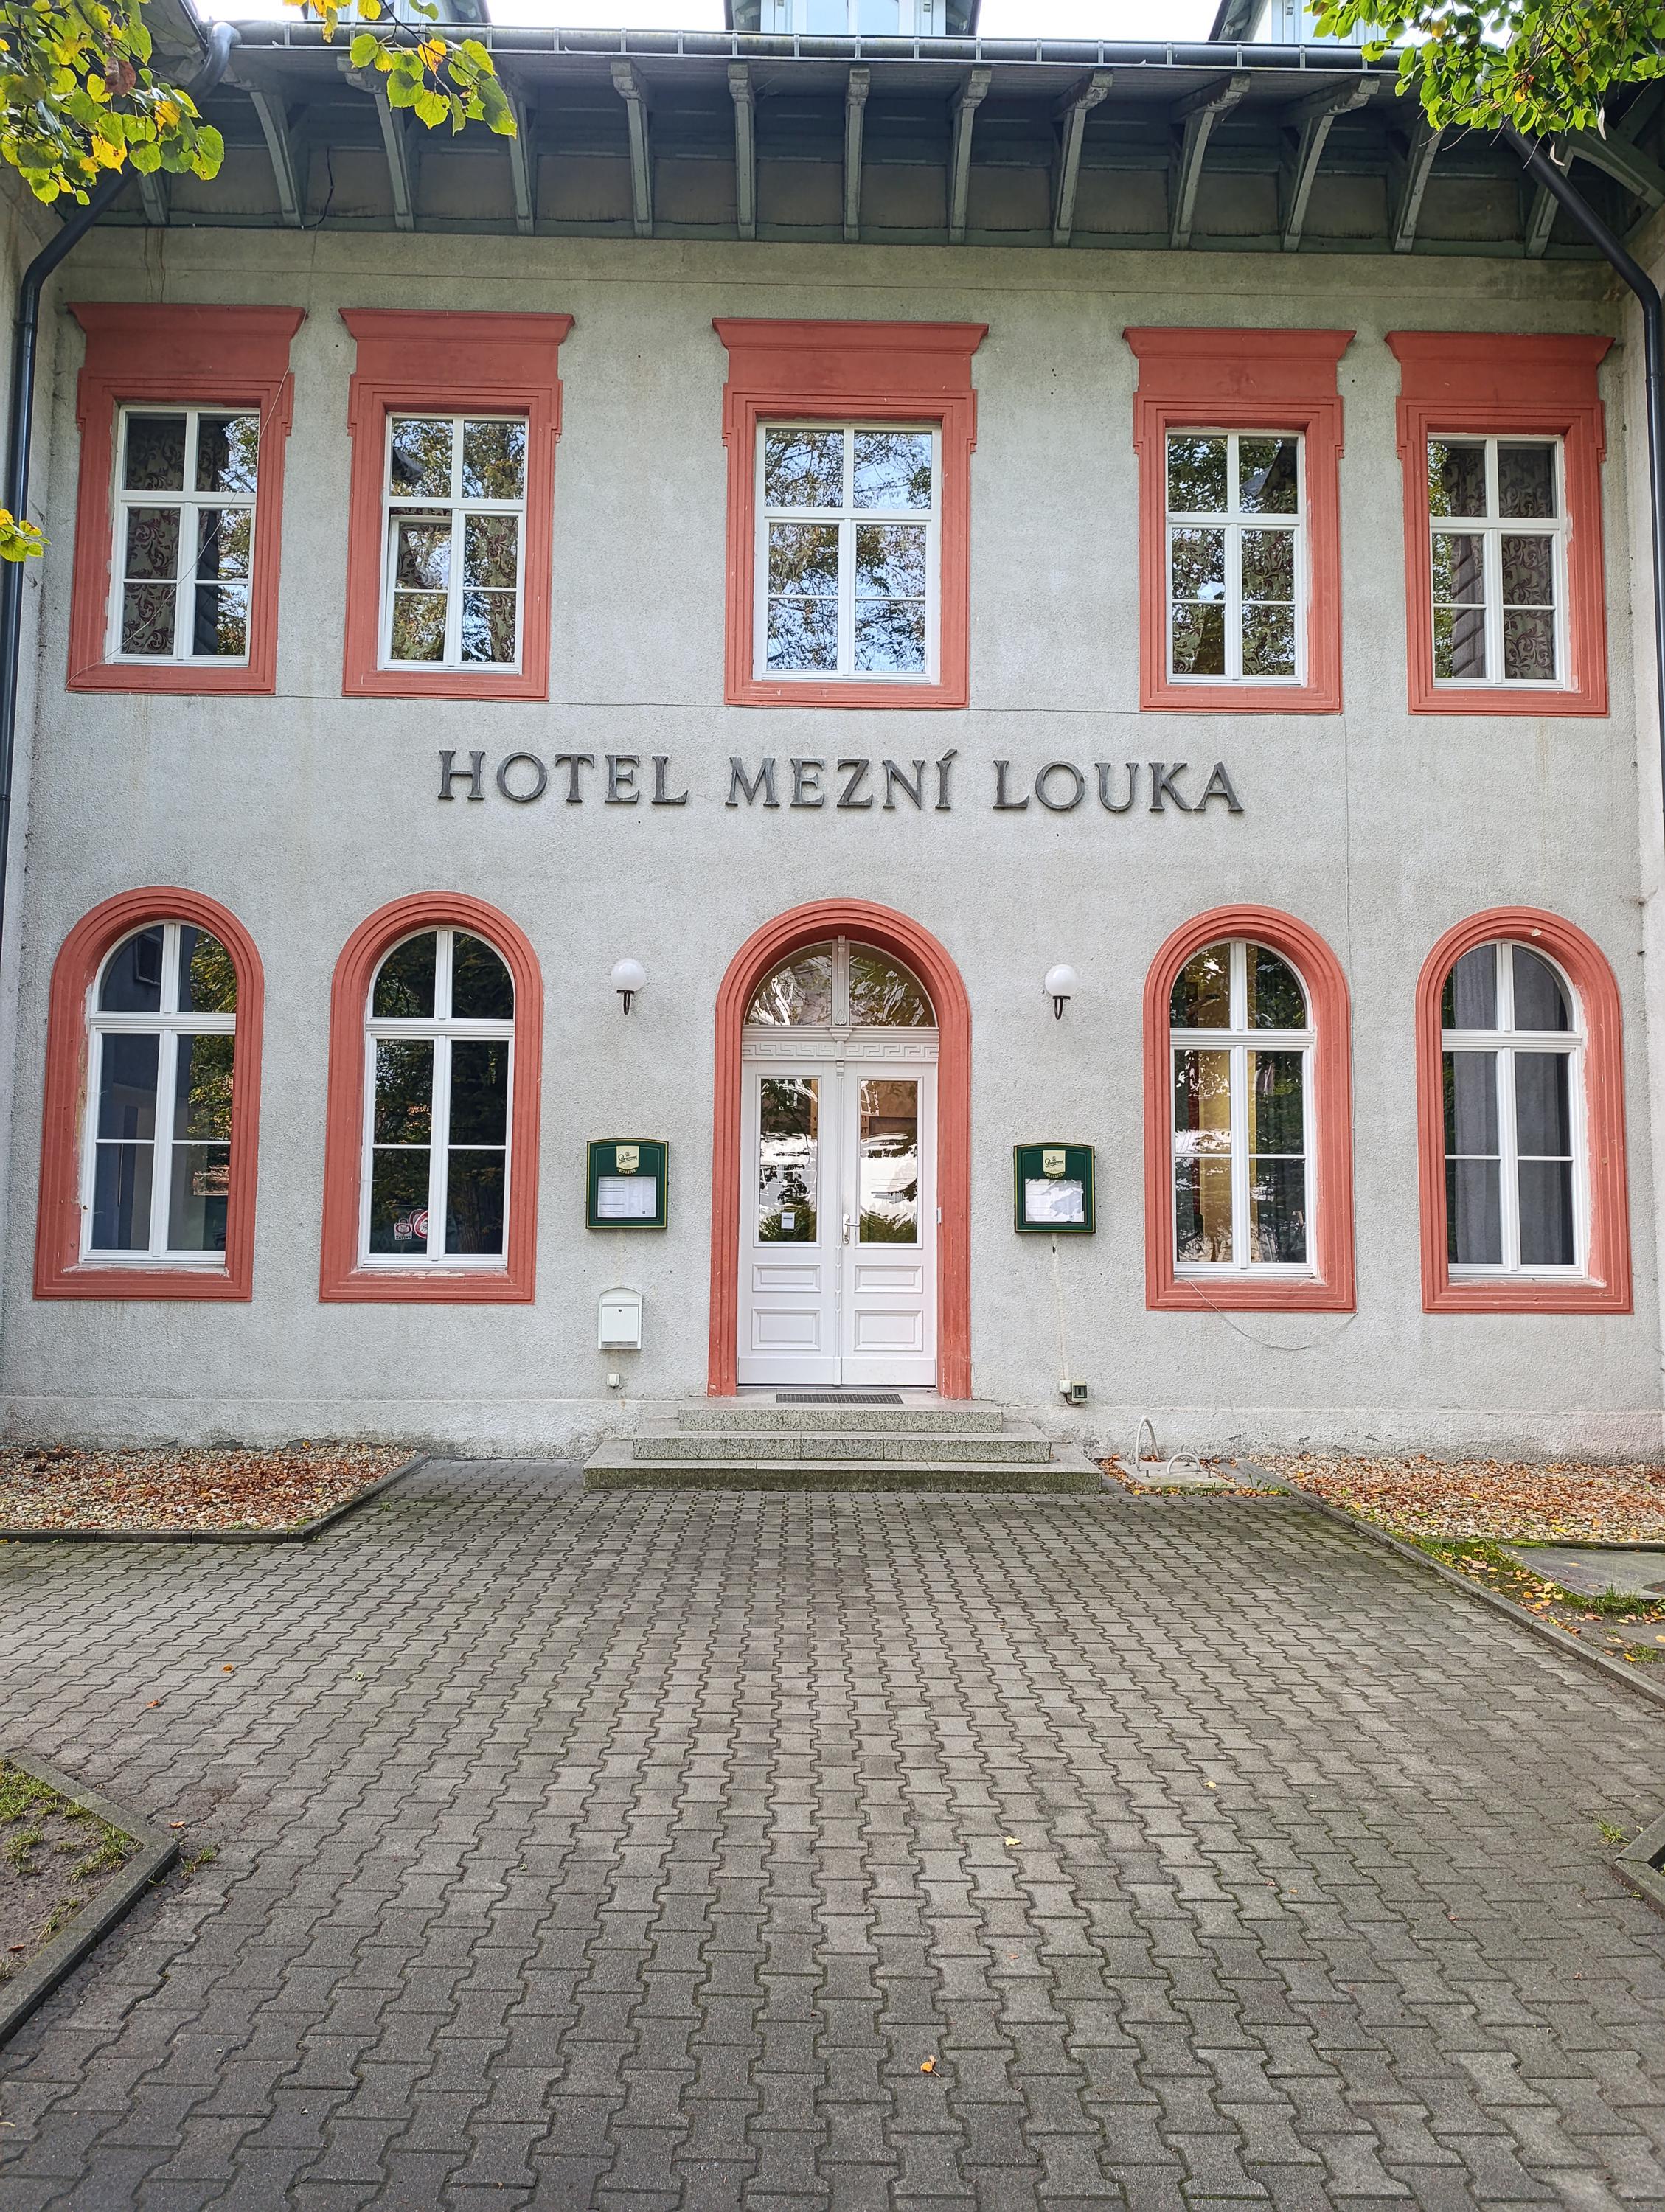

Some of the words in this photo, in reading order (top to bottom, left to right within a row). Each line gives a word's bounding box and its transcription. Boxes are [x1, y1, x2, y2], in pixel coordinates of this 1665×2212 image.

[438, 749, 689, 804] HOTEL
[725, 748, 958, 810] MEZNÍ
[993, 759, 1245, 813] LOUKA
